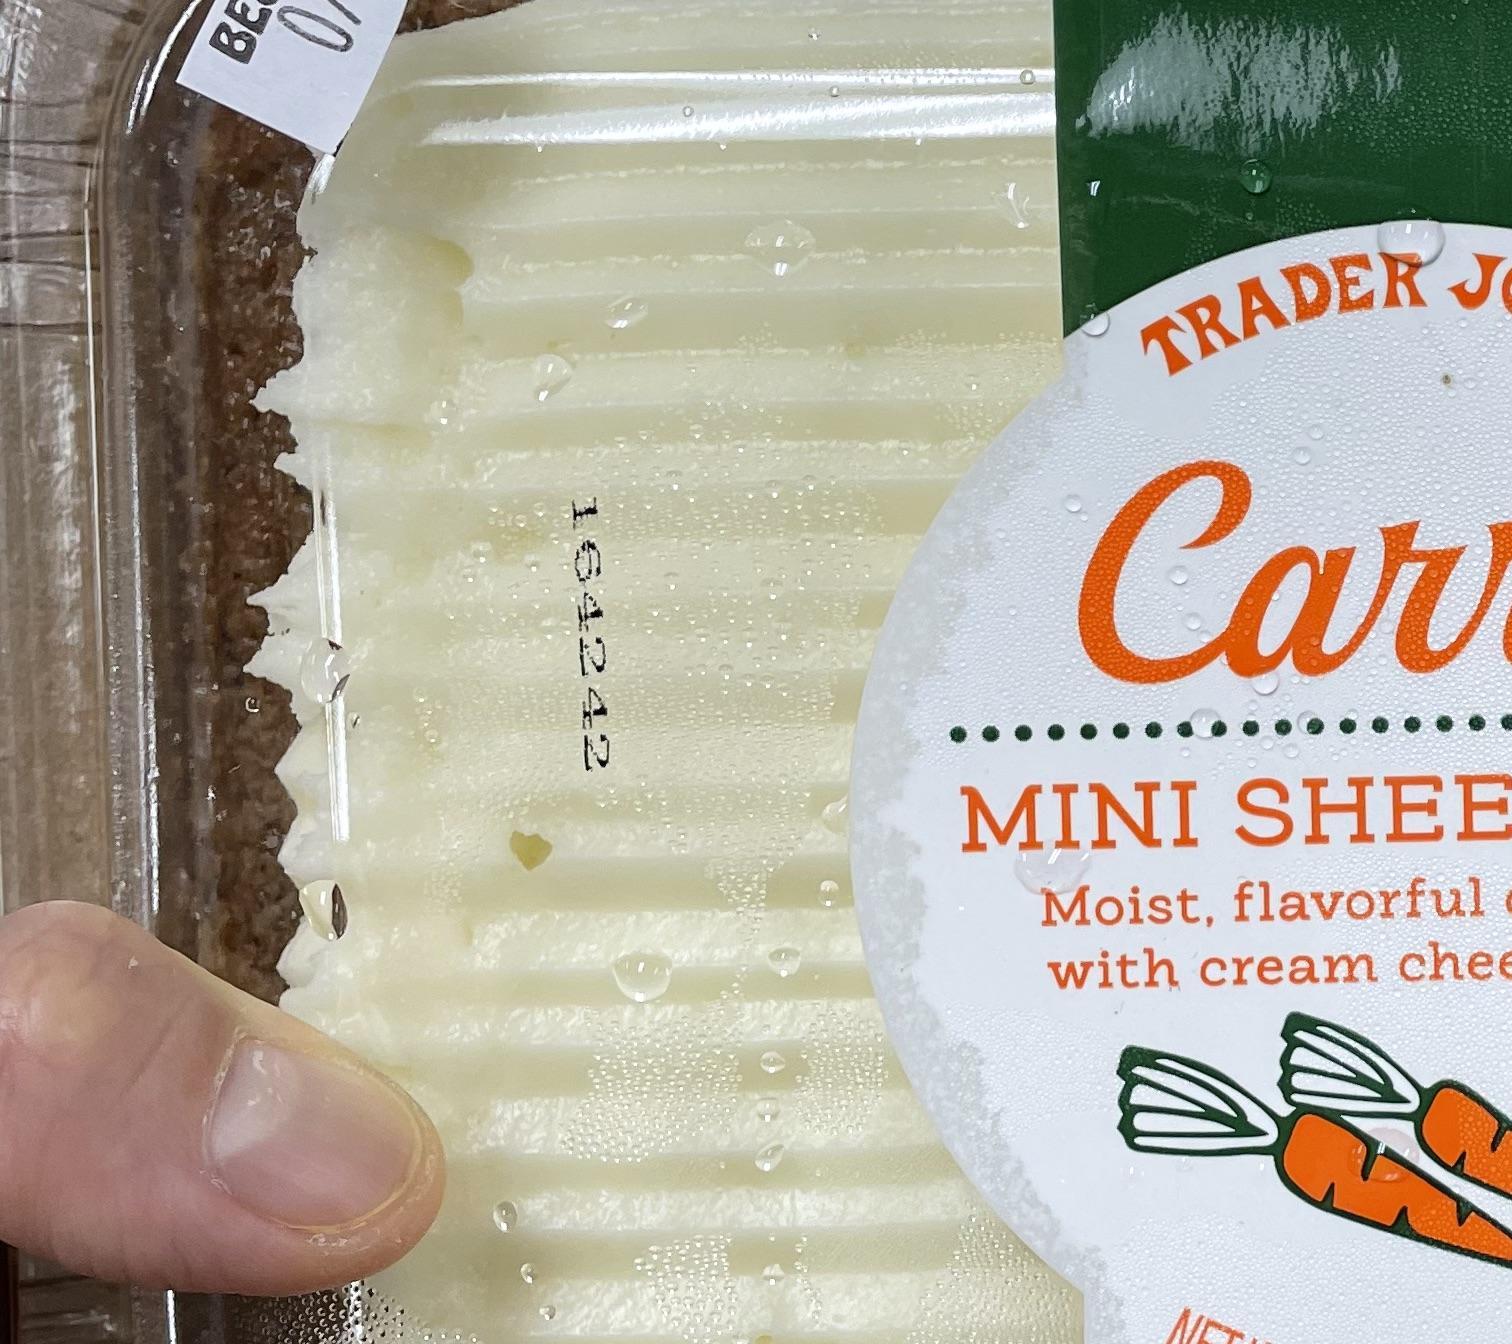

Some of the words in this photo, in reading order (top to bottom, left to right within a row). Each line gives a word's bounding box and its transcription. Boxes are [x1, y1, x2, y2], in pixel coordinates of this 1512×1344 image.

[1140, 251, 1427, 376] TRADER
[572, 498, 609, 770] 164242
[960, 781, 1198, 853] MINI
[1042, 885, 1212, 926] Moist,
[1236, 878, 1482, 921] flavorful
[1048, 948, 1177, 988] with
[1200, 955, 1375, 986] cream
